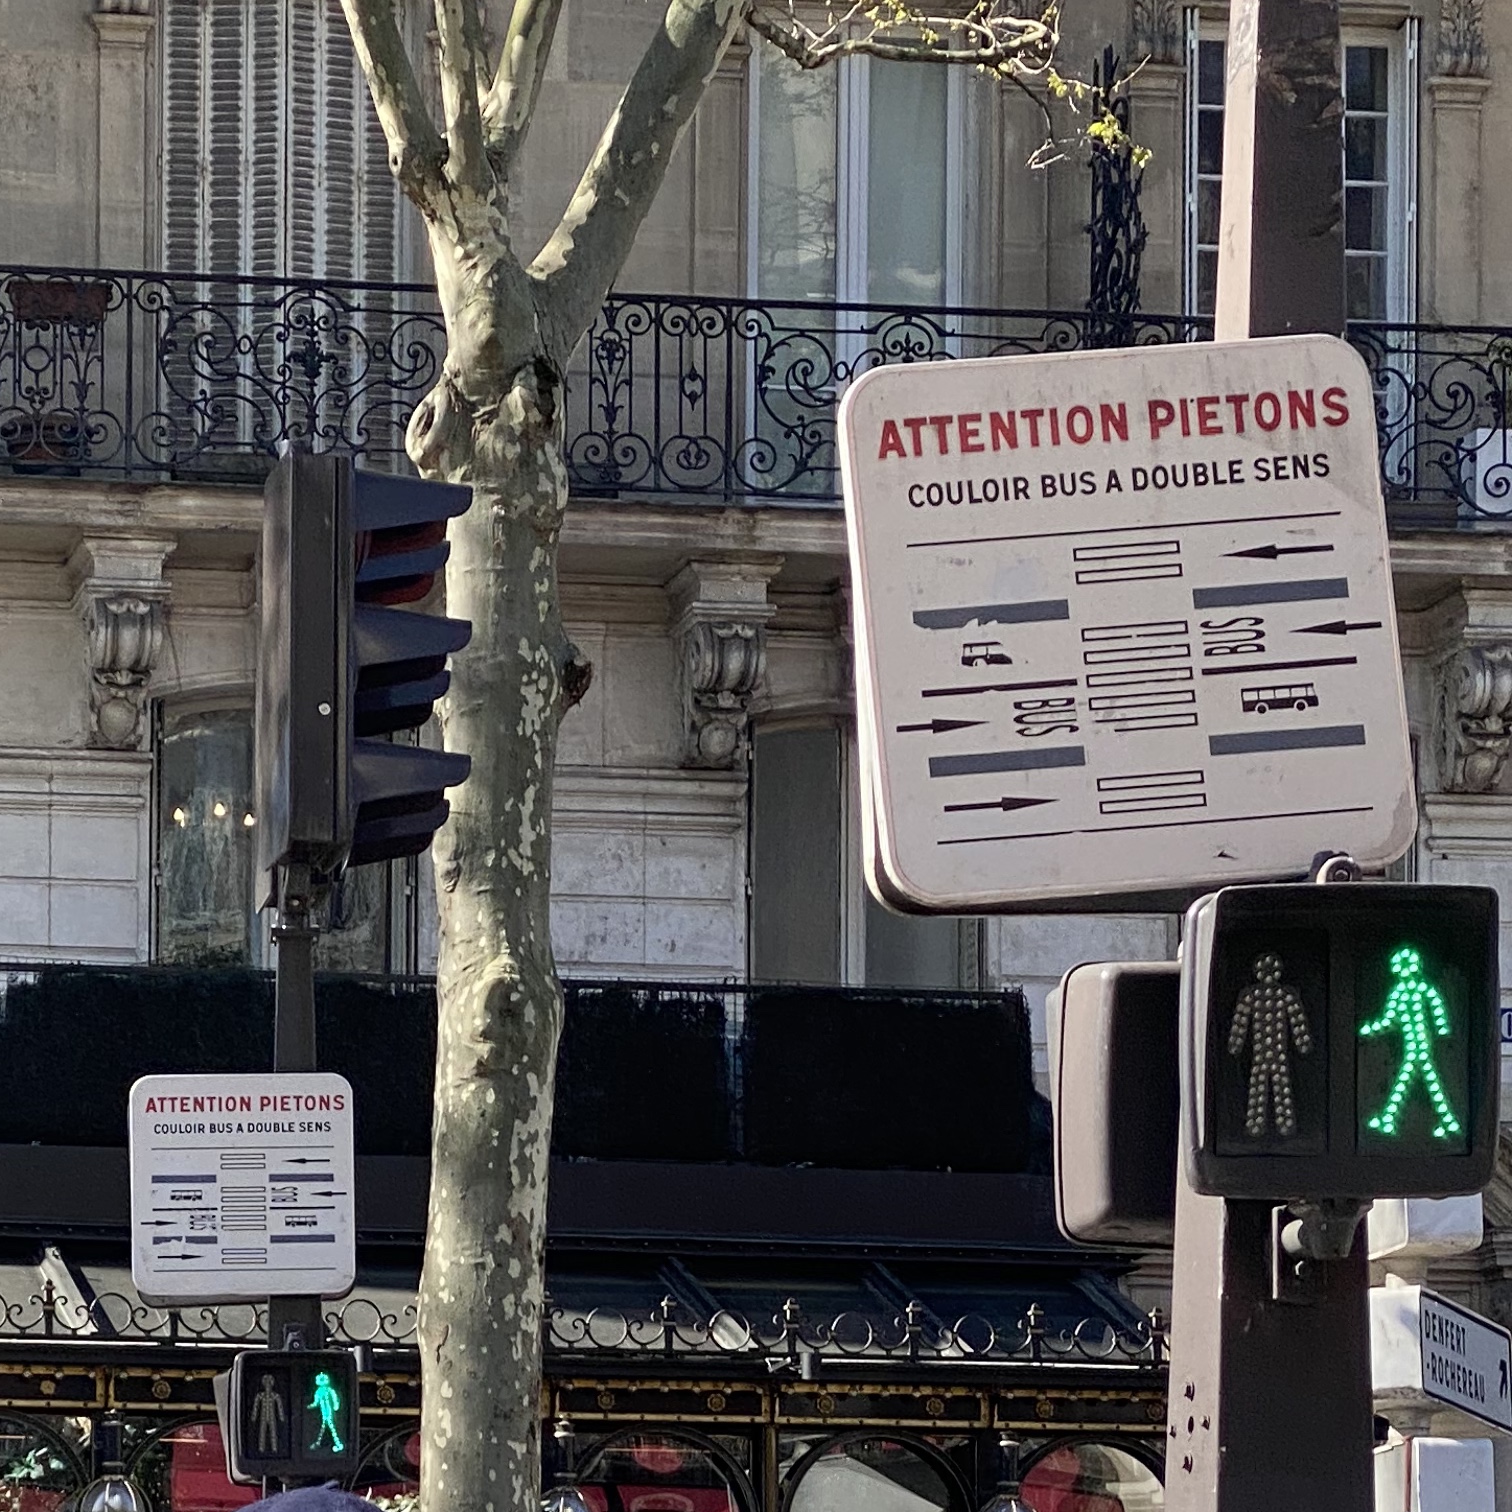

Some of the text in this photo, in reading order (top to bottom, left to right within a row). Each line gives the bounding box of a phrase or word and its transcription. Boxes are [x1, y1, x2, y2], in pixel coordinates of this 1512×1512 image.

[879, 387, 1349, 459] ATTENTION PIETONS
[909, 453, 1329, 507] COULOIR BUS A DOUBLE SENS
[1200, 617, 1265, 656] BUS
[1014, 698, 1079, 737] BUS
[146, 1095, 344, 1113] ATTENTION PIETONS
[154, 1122, 331, 1134] COULOIR BUS A DOUBLE SENS
[1424, 1309, 1465, 1357] DENFERT
[1426, 1352, 1485, 1403] -ROCHEREAU
